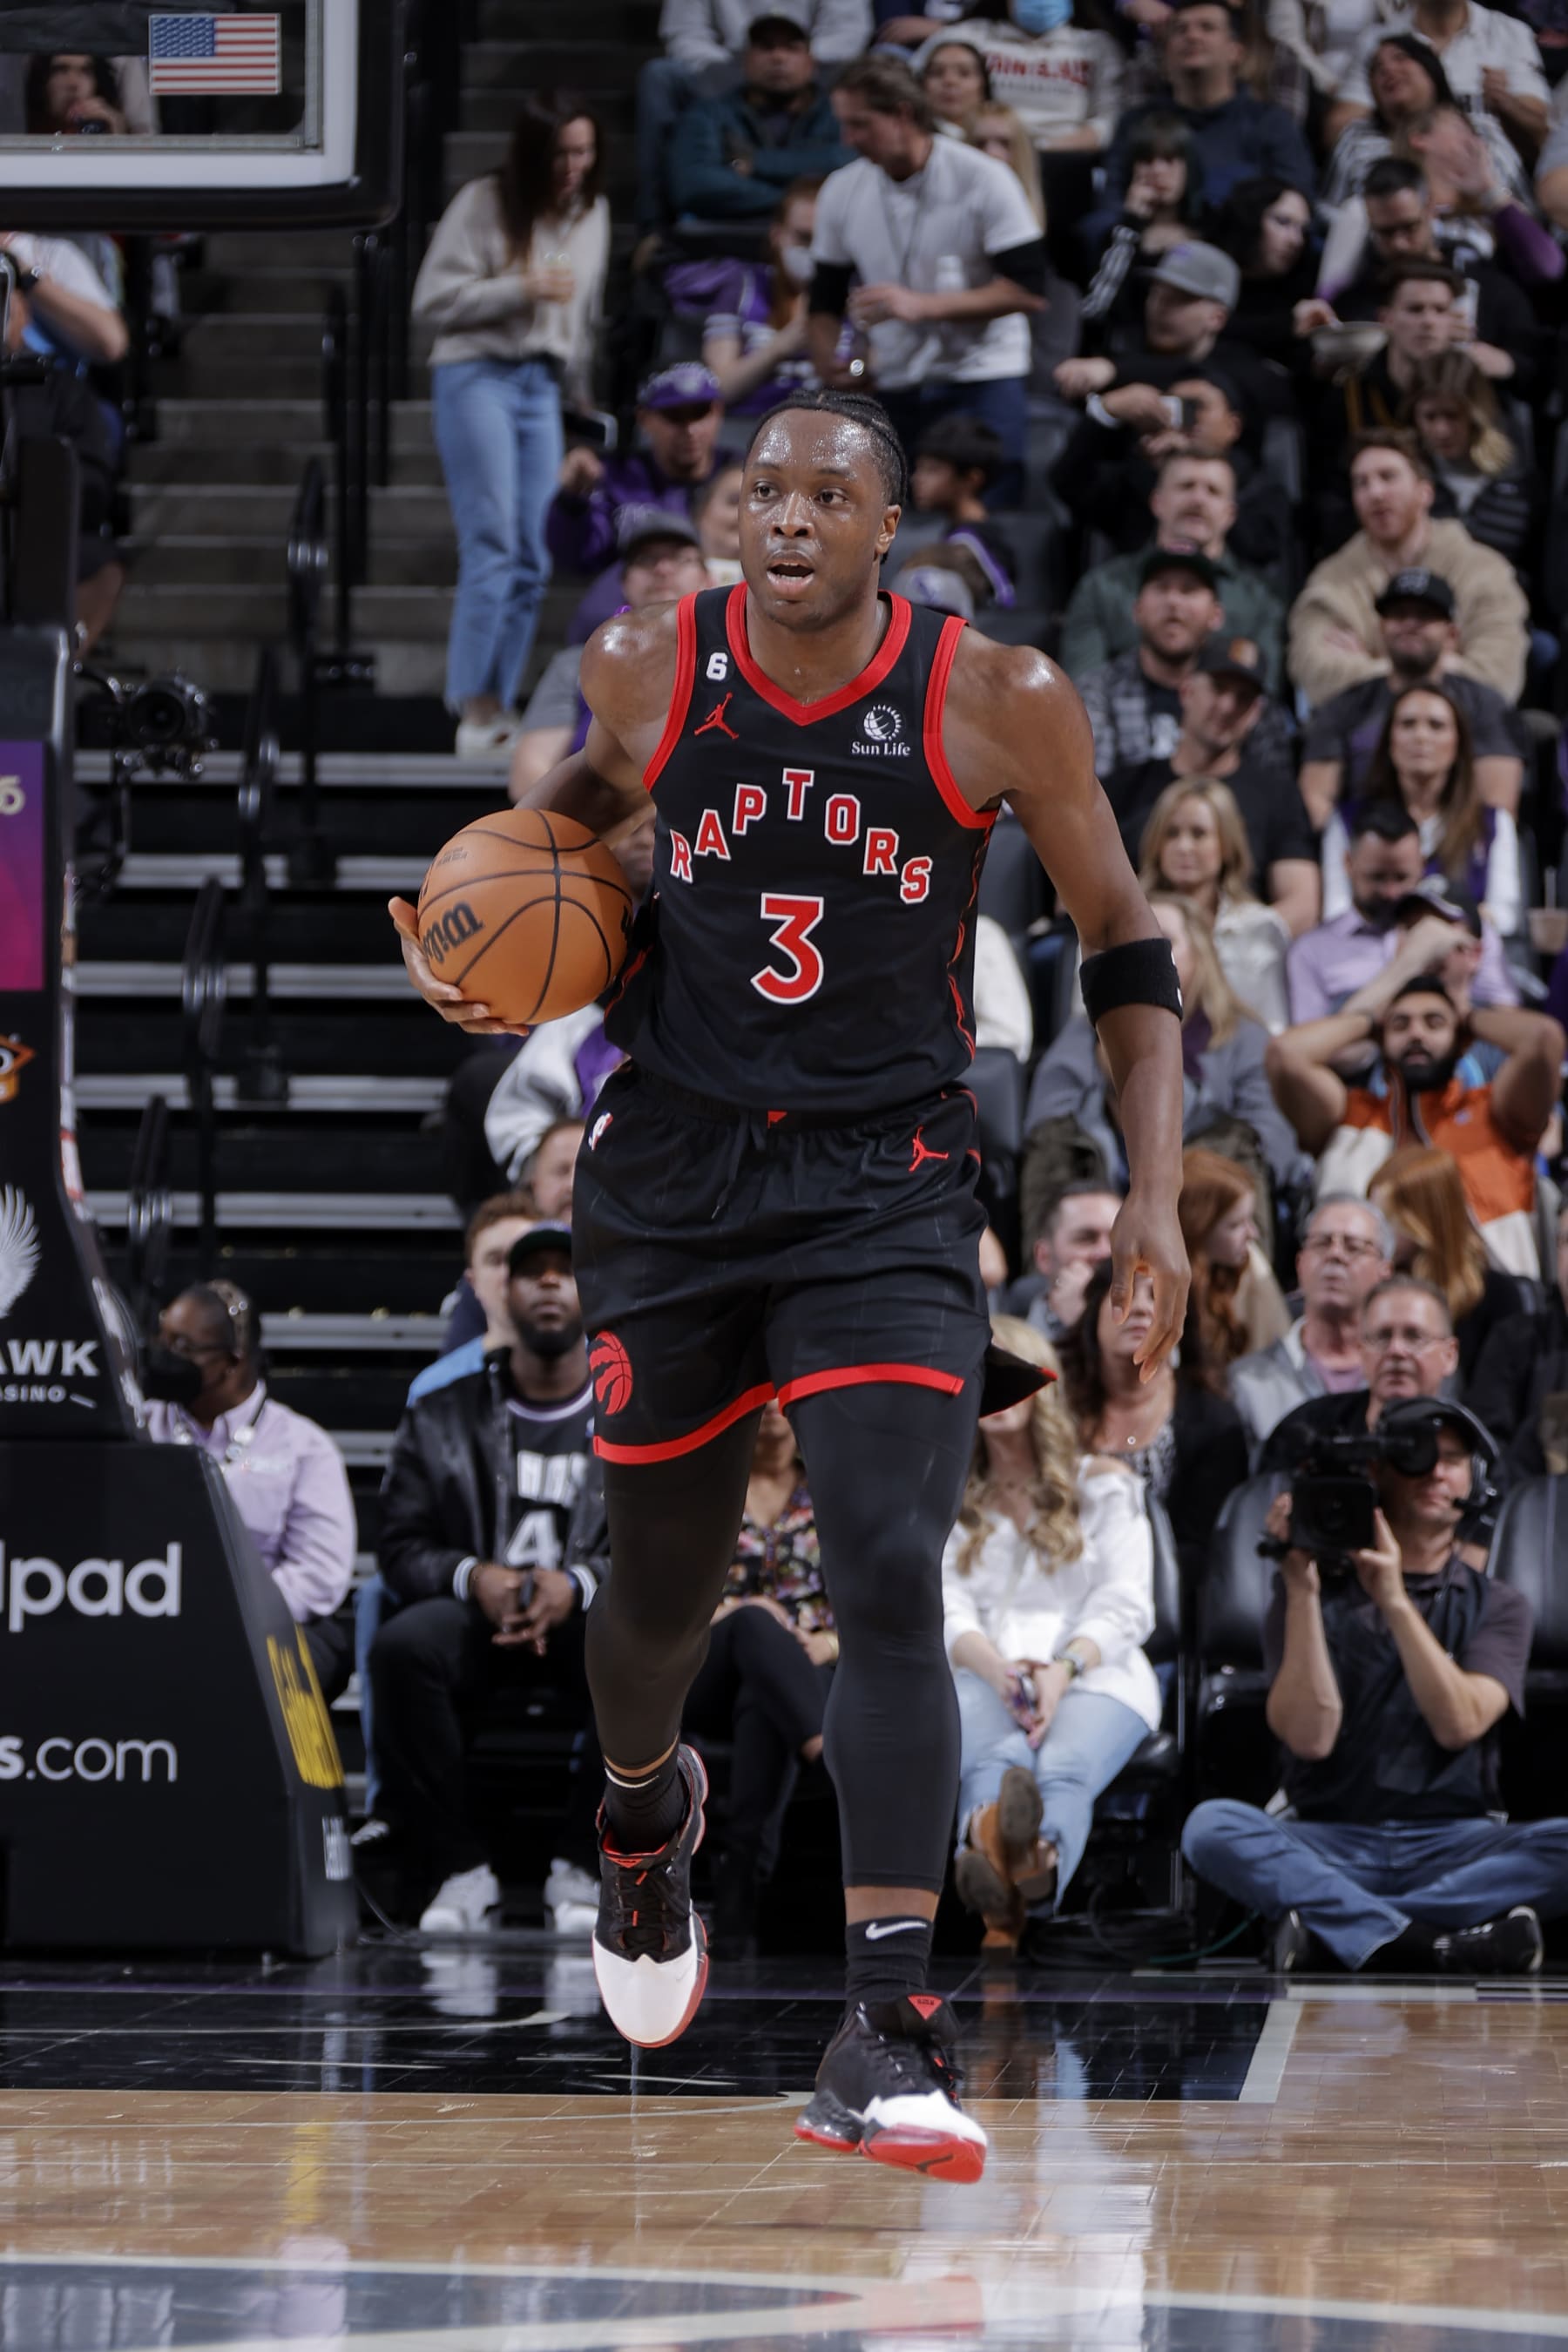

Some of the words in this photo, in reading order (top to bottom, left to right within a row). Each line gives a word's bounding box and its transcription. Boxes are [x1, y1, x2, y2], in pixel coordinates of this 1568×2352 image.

[706, 652, 728, 680] 6
[851, 740, 880, 755] Sun
[883, 741, 911, 756] Life
[669, 767, 933, 904] RAPTORS
[750, 892, 824, 1004] 3
[0, 1339, 99, 1376] WK
[0, 1383, 66, 1402] SINO
[505, 1510, 563, 1571] 4
